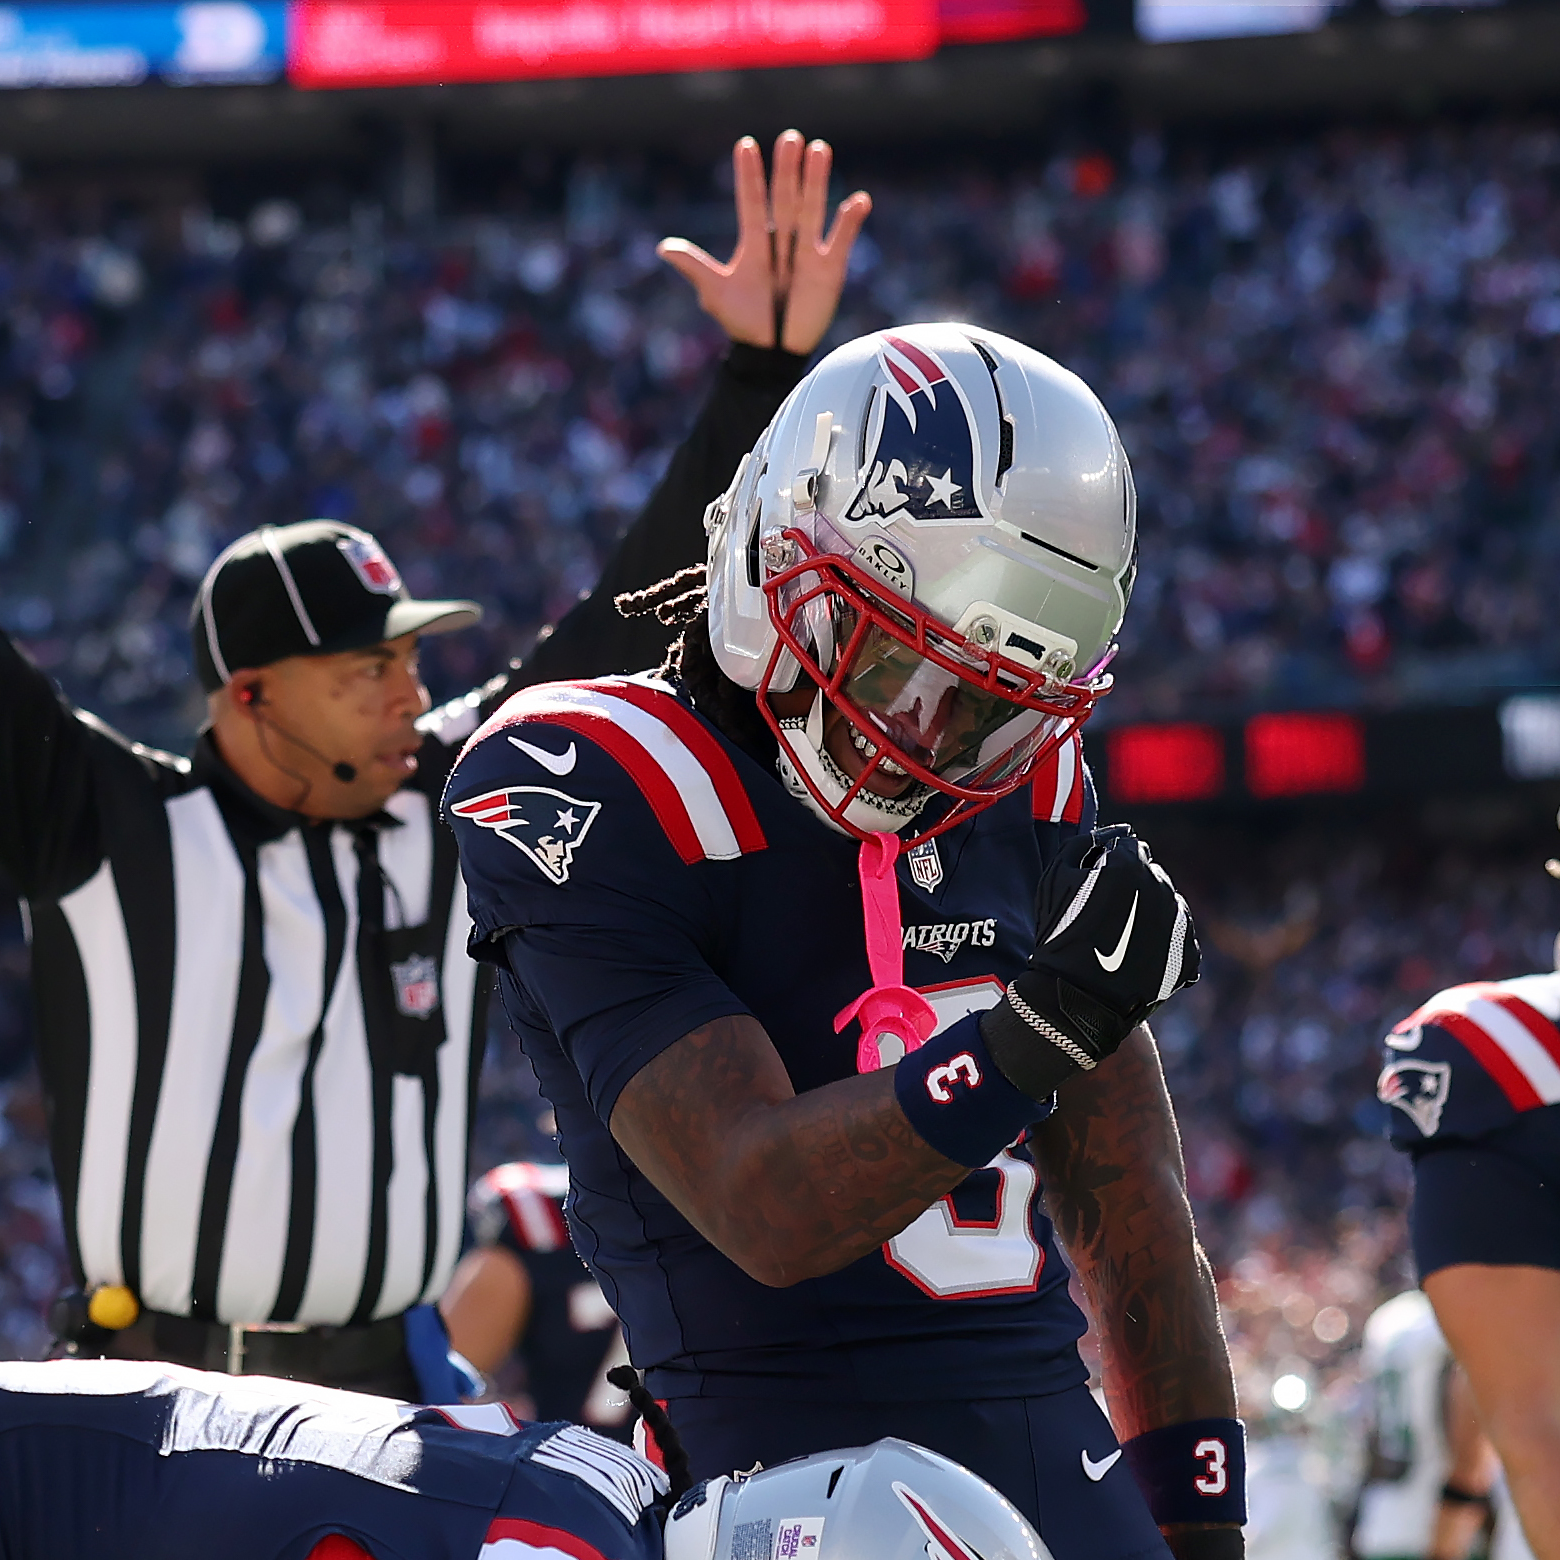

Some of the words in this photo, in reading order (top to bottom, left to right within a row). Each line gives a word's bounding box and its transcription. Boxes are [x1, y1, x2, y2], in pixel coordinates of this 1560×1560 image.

[857, 546, 910, 592] OAKLEY
[913, 858, 940, 882] NFL
[901, 917, 997, 951] ATRIOTS
[923, 1050, 985, 1105] 3
[1192, 1436, 1231, 1497] 3
